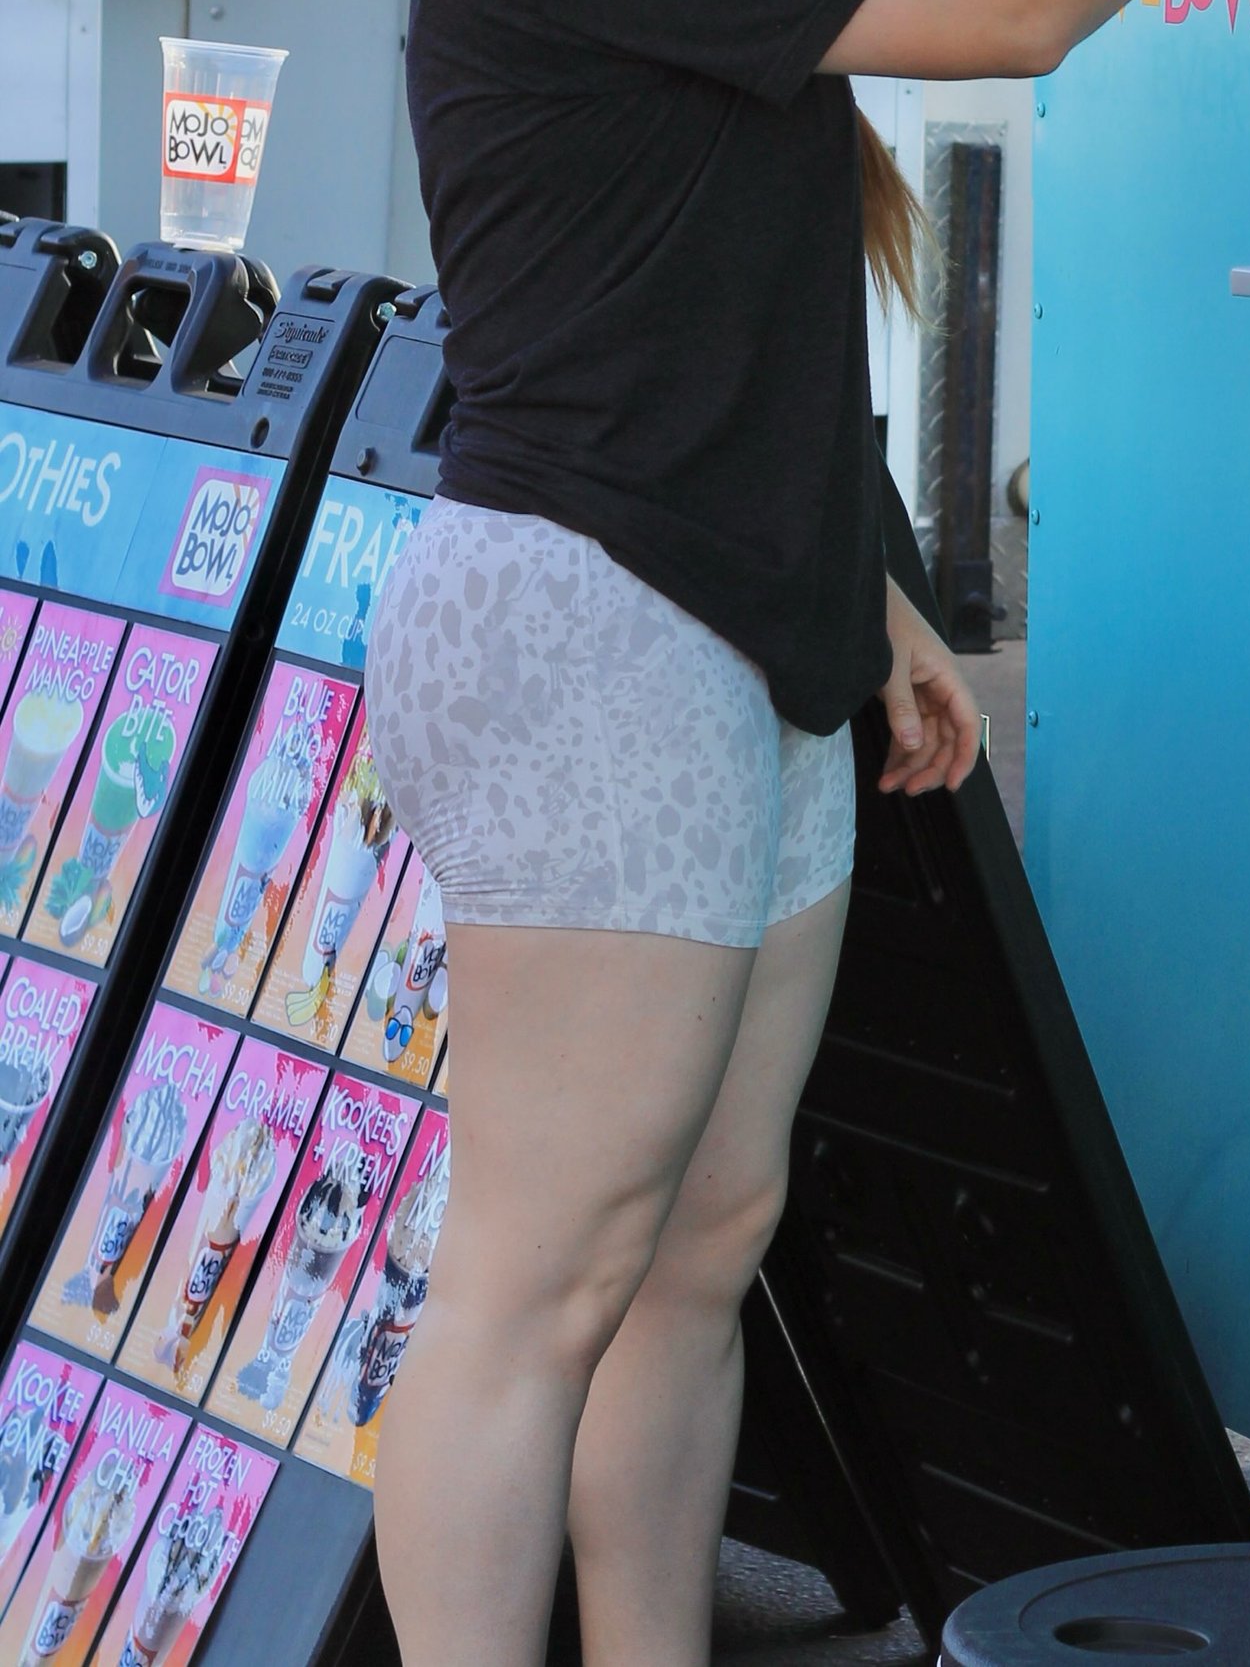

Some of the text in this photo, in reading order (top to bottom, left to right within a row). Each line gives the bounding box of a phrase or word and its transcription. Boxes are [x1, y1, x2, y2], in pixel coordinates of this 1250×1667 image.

[169, 107, 229, 137] MOJO
[169, 136, 227, 166] BOWL
[192, 488, 250, 537] MOJO
[176, 531, 238, 583] BOWL
[291, 602, 312, 628] 24
[313, 608, 336, 635] OZ
[29, 625, 114, 673] PINEAPPLE
[25, 660, 95, 702] MANGO
[126, 647, 200, 704] GATOR
[284, 676, 335, 724] BLUE
[121, 694, 173, 742] BITE
[6, 977, 81, 1037] COALED
[221, 980, 249, 1007] $9.50
[0, 1021, 63, 1074] BREW
[136, 1031, 218, 1097] MOCHA
[401, 1051, 429, 1075] $9.50
[225, 1072, 310, 1137] CARAMEL
[322, 1085, 407, 1155] KOOKEES
[324, 1136, 393, 1199] KREEM
[8, 1359, 84, 1423] KOOKEE
[0, 1403, 69, 1473] ONKEE
[100, 1397, 174, 1461] VANILLA
[262, 1410, 291, 1435] $9.50
[97, 1447, 146, 1499] CHAI
[188, 1434, 252, 1489] FROZEN
[184, 1477, 217, 1513] HOT
[158, 1502, 240, 1564] CHOCOLATE
